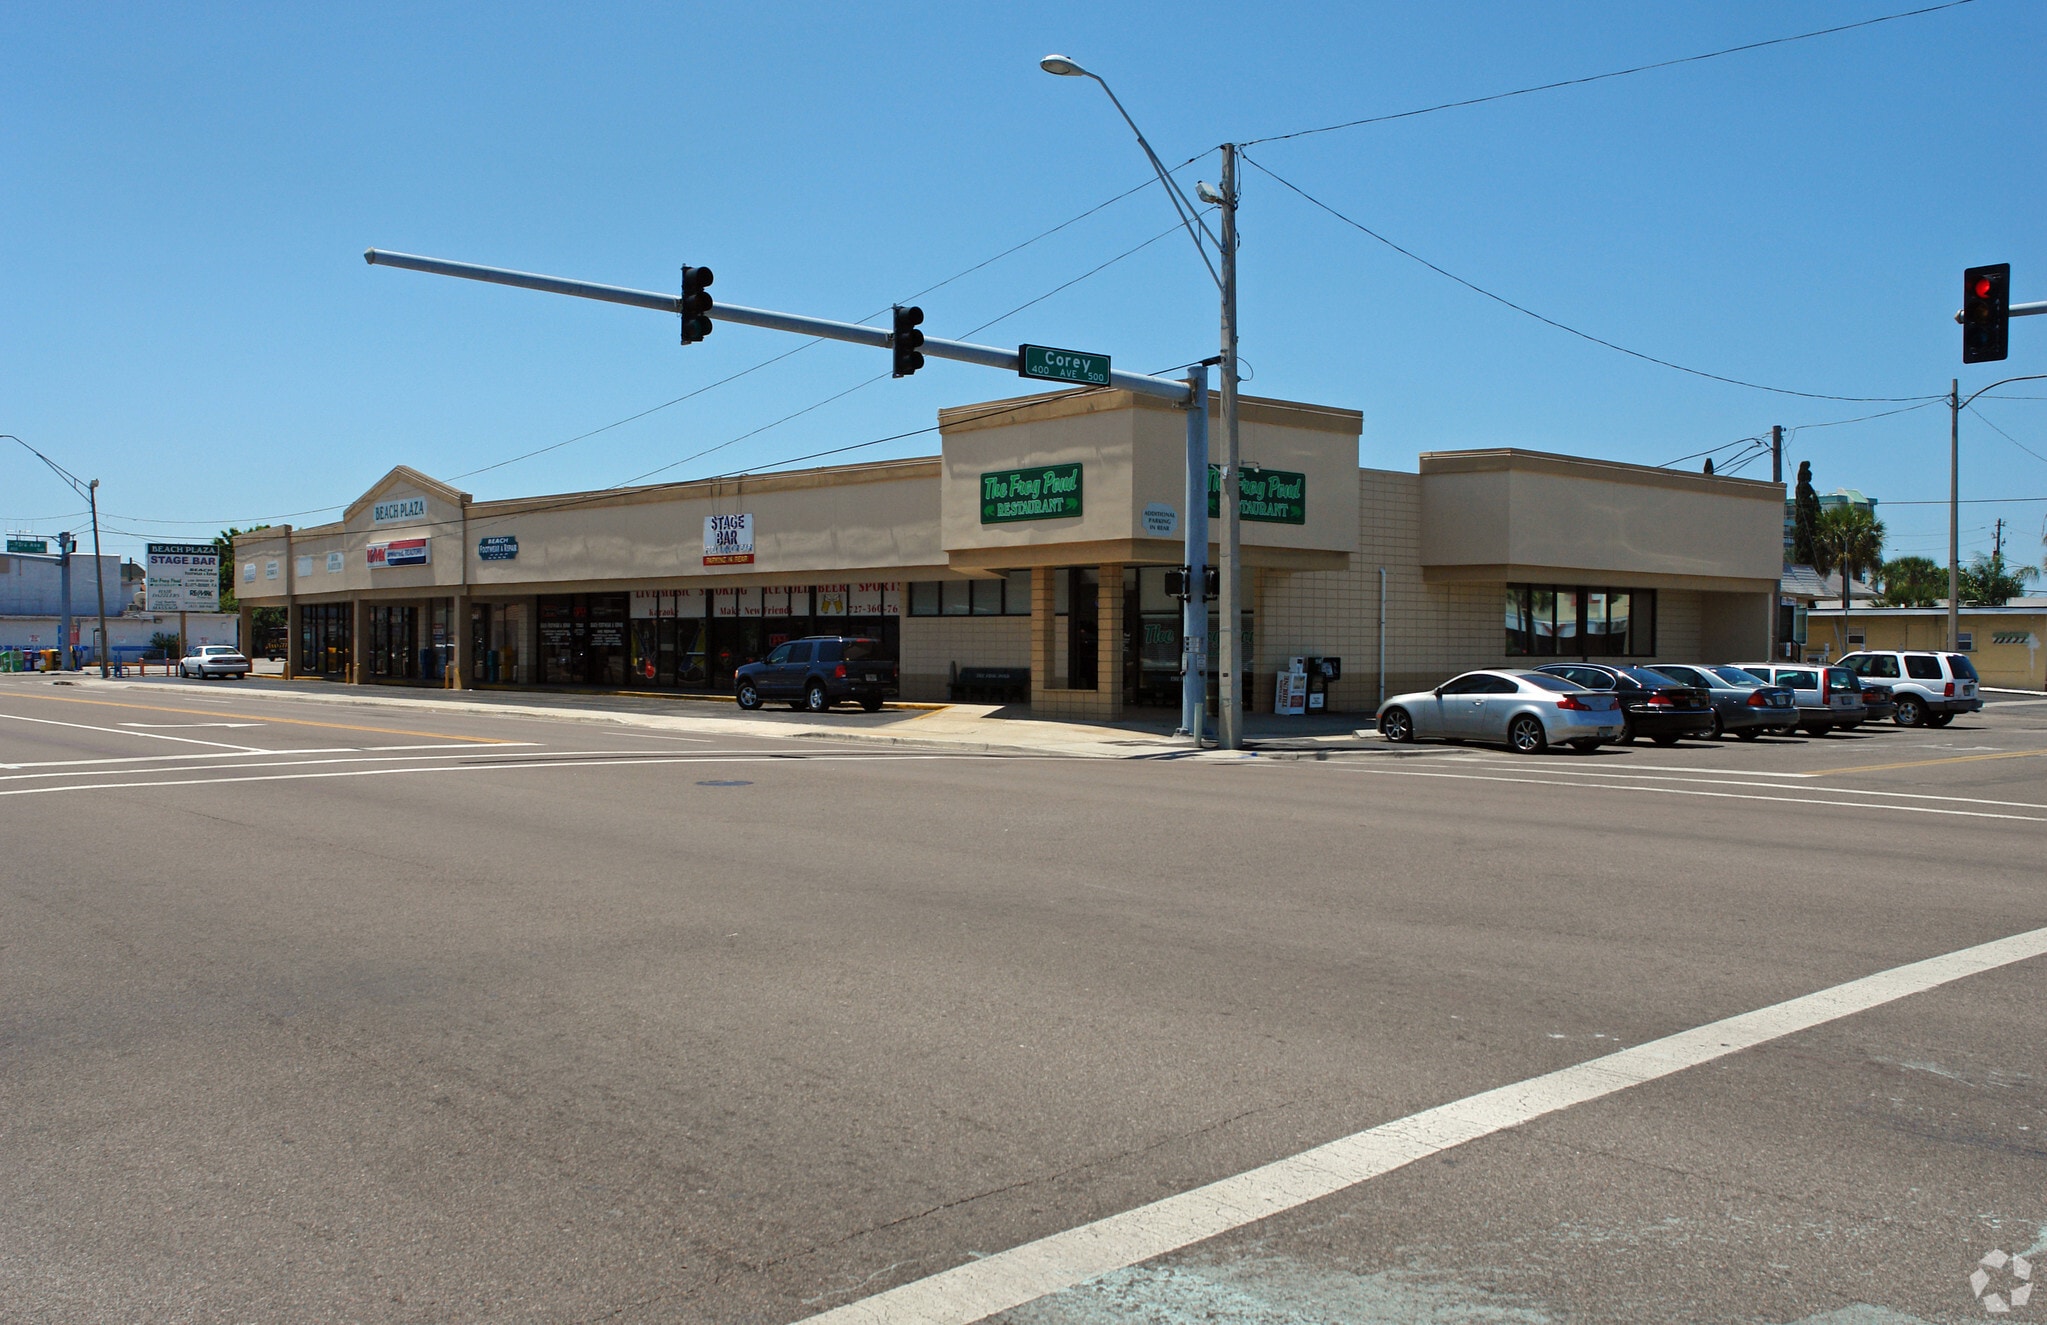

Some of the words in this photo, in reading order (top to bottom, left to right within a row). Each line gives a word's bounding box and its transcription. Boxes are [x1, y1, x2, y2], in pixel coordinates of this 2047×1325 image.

[1045, 351, 1091, 373] Corey
[1032, 365, 1049, 374] 400
[1060, 369, 1077, 378] AVE
[1088, 372, 1104, 382] 500
[985, 477, 1008, 500] The
[1009, 474, 1041, 499] Frog
[1043, 468, 1078, 495] Pond
[1268, 475, 1302, 499] Pond
[375, 503, 399, 521] BEACH
[400, 500, 424, 517] PLAZA
[997, 497, 1064, 517] RESTAURANT
[1144, 510, 1175, 518] ADDITIONAL
[1240, 499, 1289, 517] TAURANT
[711, 514, 745, 531] STAGE
[1148, 517, 1171, 525] PARKING
[717, 530, 738, 546] BAR
[152, 545, 183, 553] BEACH
[185, 546, 216, 554] PLAZA
[150, 555, 189, 565] STAGE
[192, 556, 216, 565] BAR
[636, 589, 657, 598] LIVE
[660, 589, 690, 597] MUSIC
[699, 587, 747, 596] SOKING
[764, 585, 781, 594] ICE
[817, 583, 847, 593] BEER
[649, 607, 679, 617] Karaoke
[720, 606, 741, 615] Make
[745, 606, 761, 615] New
[1144, 624, 1175, 644] The
